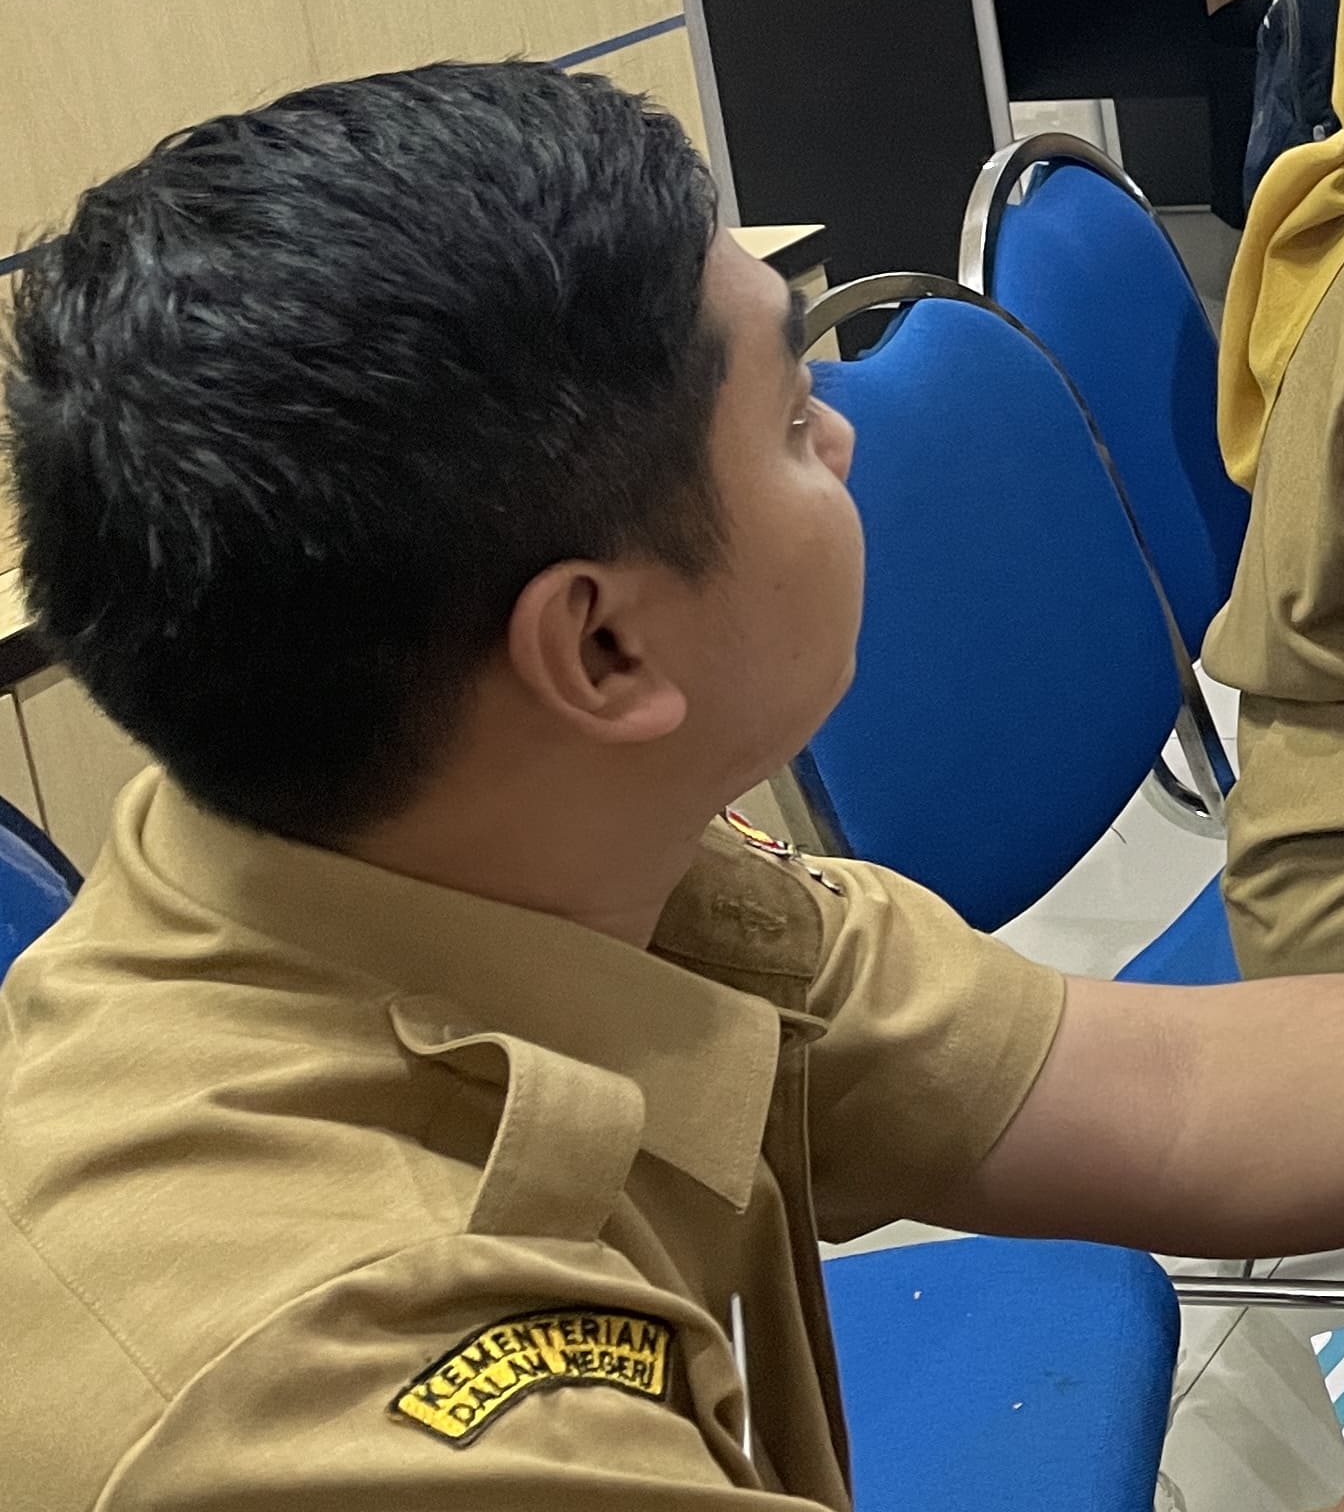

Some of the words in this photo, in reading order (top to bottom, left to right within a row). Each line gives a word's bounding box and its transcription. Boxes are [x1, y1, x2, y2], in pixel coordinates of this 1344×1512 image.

[414, 1319, 660, 1410] KEMENTERIAN
[449, 1350, 551, 1426] DALAM
[565, 1348, 652, 1389] NEGERI
